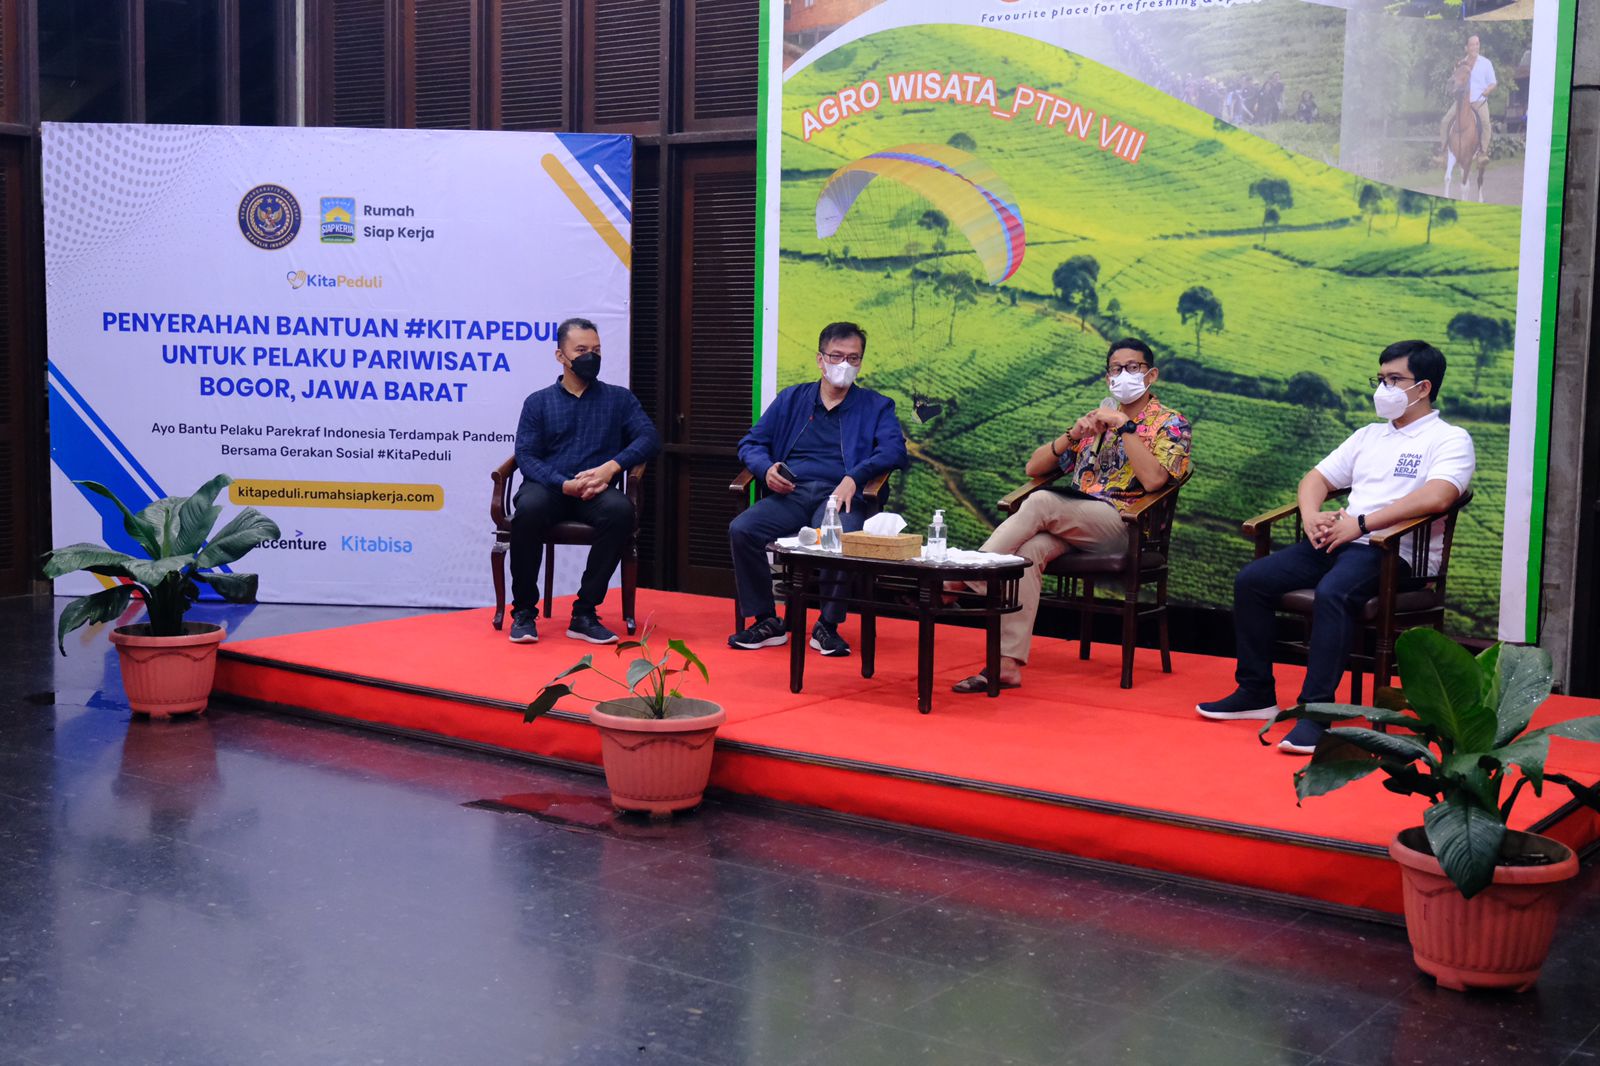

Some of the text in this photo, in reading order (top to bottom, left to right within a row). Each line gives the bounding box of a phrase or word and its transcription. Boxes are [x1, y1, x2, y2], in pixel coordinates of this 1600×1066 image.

[981, 0, 1197, 23] Favourite place for refreshing
[801, 82, 880, 139] AGRO
[1100, 117, 1145, 162] VIII
[363, 205, 415, 217] Rumah
[363, 226, 435, 243] Siap Kerja
[307, 274, 383, 289] KitaPeduli
[102, 311, 559, 342] PENYERAHAN BANTUAN #KITAPEDUL
[162, 344, 511, 373] UNTUK PELAKU PARIWISATA
[199, 376, 468, 403] BOGOR, JAWA BARAT
[151, 422, 516, 445] Ayo Bantu Pelaku Parekraf Indonesia Terdampak Pandem
[221, 444, 452, 462] Bersama Gerakan Sosial #KitaPeduli
[1397, 459, 1421, 468] SIAP
[237, 486, 435, 504] kitapeduli.rumahsiapkerja.com
[341, 536, 413, 554] Kitabisa
